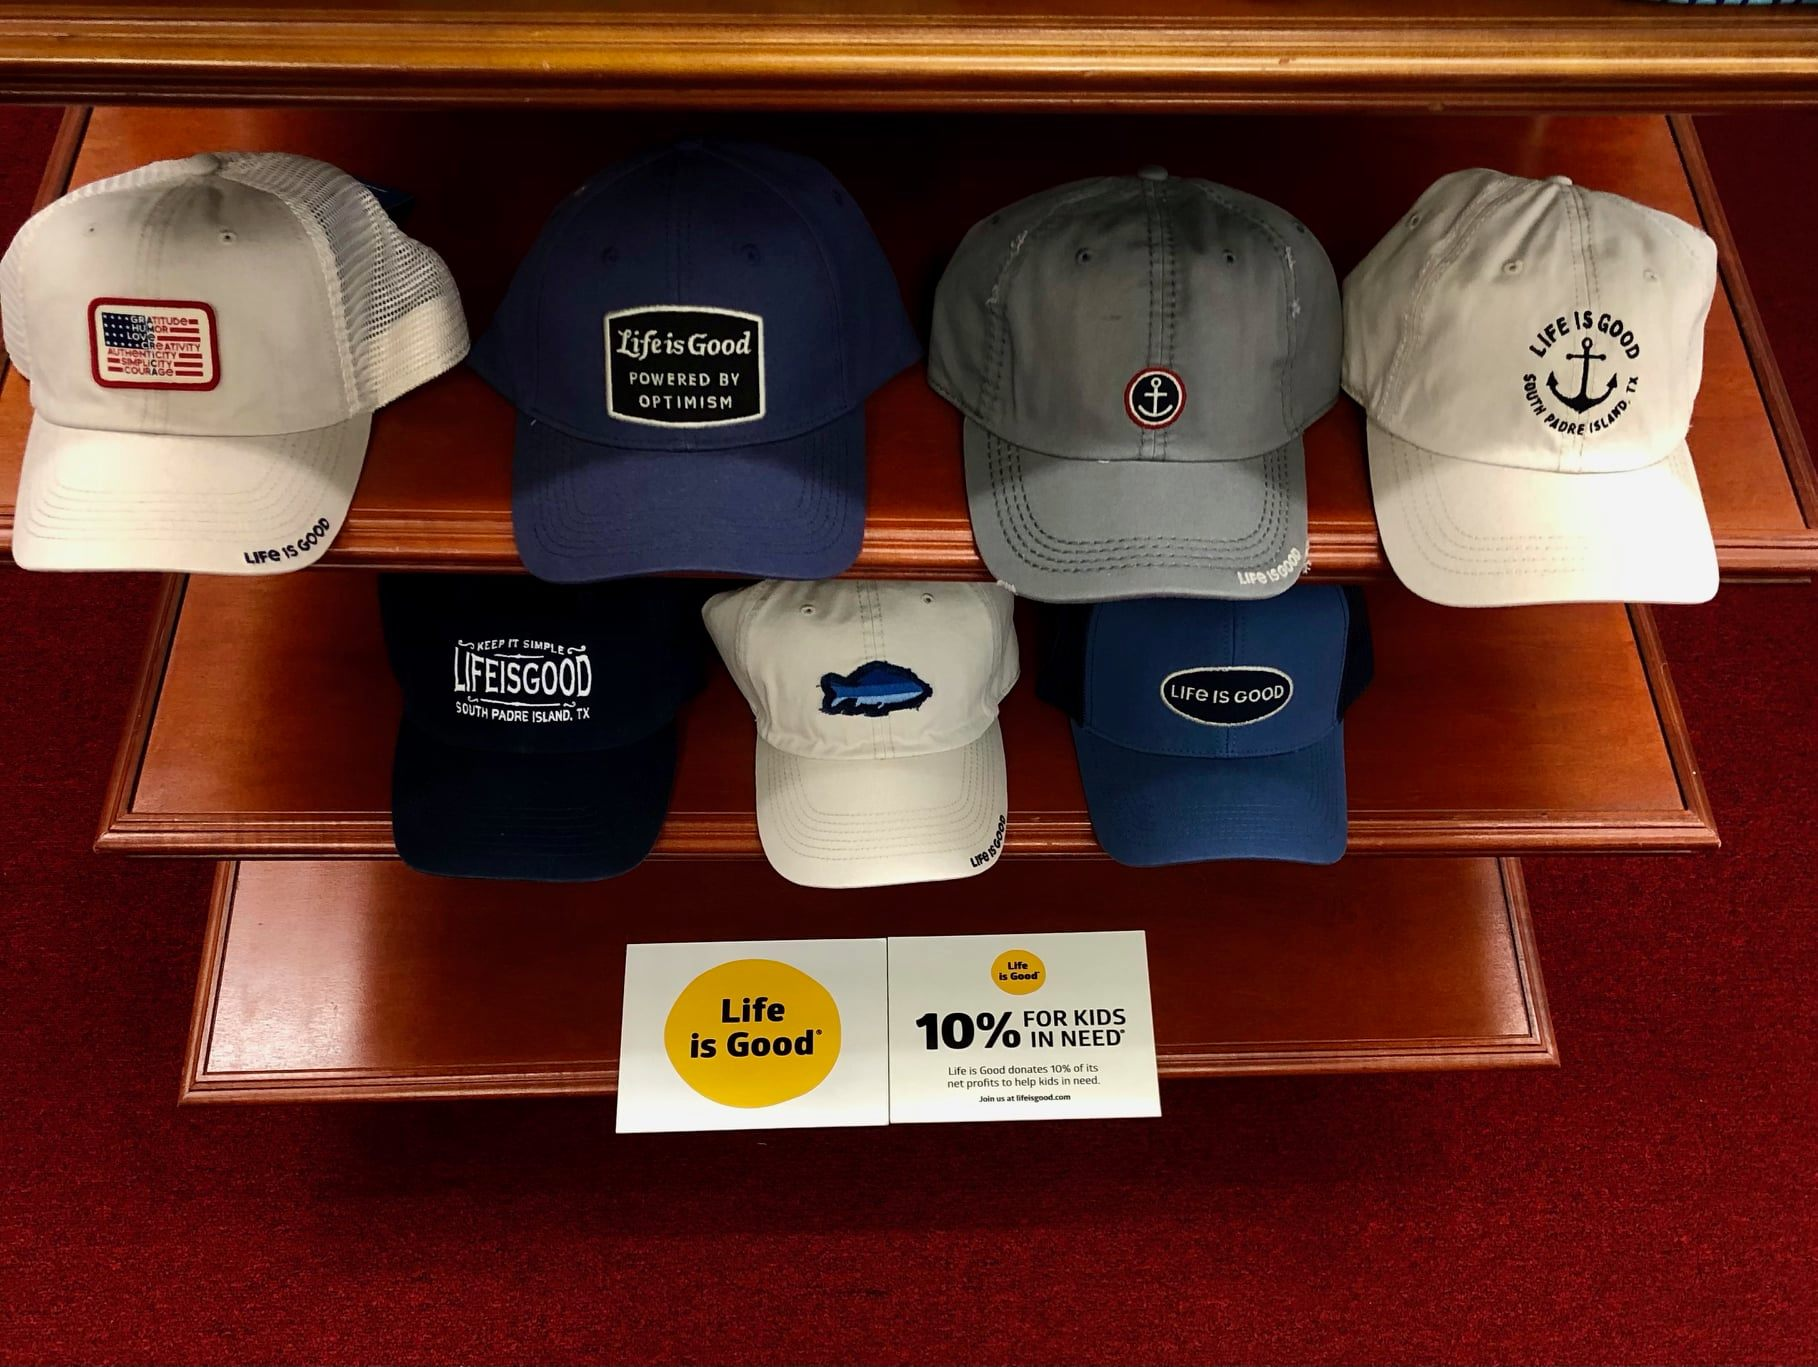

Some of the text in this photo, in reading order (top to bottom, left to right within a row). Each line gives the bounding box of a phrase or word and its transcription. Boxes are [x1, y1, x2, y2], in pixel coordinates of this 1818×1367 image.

[1529, 310, 1640, 359] LIFE IS GOOD
[616, 329, 752, 361] Life is Good
[629, 372, 740, 387] POWERED BY
[639, 394, 733, 410] OPTIMISM
[1523, 373, 1547, 416] SOUTH
[1544, 413, 1585, 435] PADRE
[1626, 376, 1639, 393] TX
[282, 544, 298, 559] IS
[297, 517, 330, 551] GOOD
[1266, 568, 1280, 582] IS
[1277, 547, 1301, 578] GOOD
[477, 638, 565, 655] KEEP IT SIMPLE
[454, 646, 592, 697] LIFEISGOOD
[1213, 690, 1230, 704] IS
[1234, 685, 1284, 704] GOOD
[456, 701, 488, 719] SOUTH
[491, 708, 529, 722] PADRE
[576, 707, 590, 720] TX
[987, 844, 997, 858] IS
[993, 814, 1006, 849] GOOD
[1007, 961, 1028, 970] Life
[998, 972, 1008, 980] is
[721, 996, 785, 1023] Life
[1023, 1008, 1126, 1027] FOR KIDS
[915, 1011, 1021, 1050] 10%
[1031, 1031, 1054, 1048] IN
[690, 1032, 717, 1058] is
[948, 1063, 1099, 1076] Life is Good donates 10% of its
[947, 1075, 1101, 1090] net profits to help kids in need.
[978, 1095, 995, 1103] Join
[1016, 1094, 1071, 1103] lifeisgood.com
